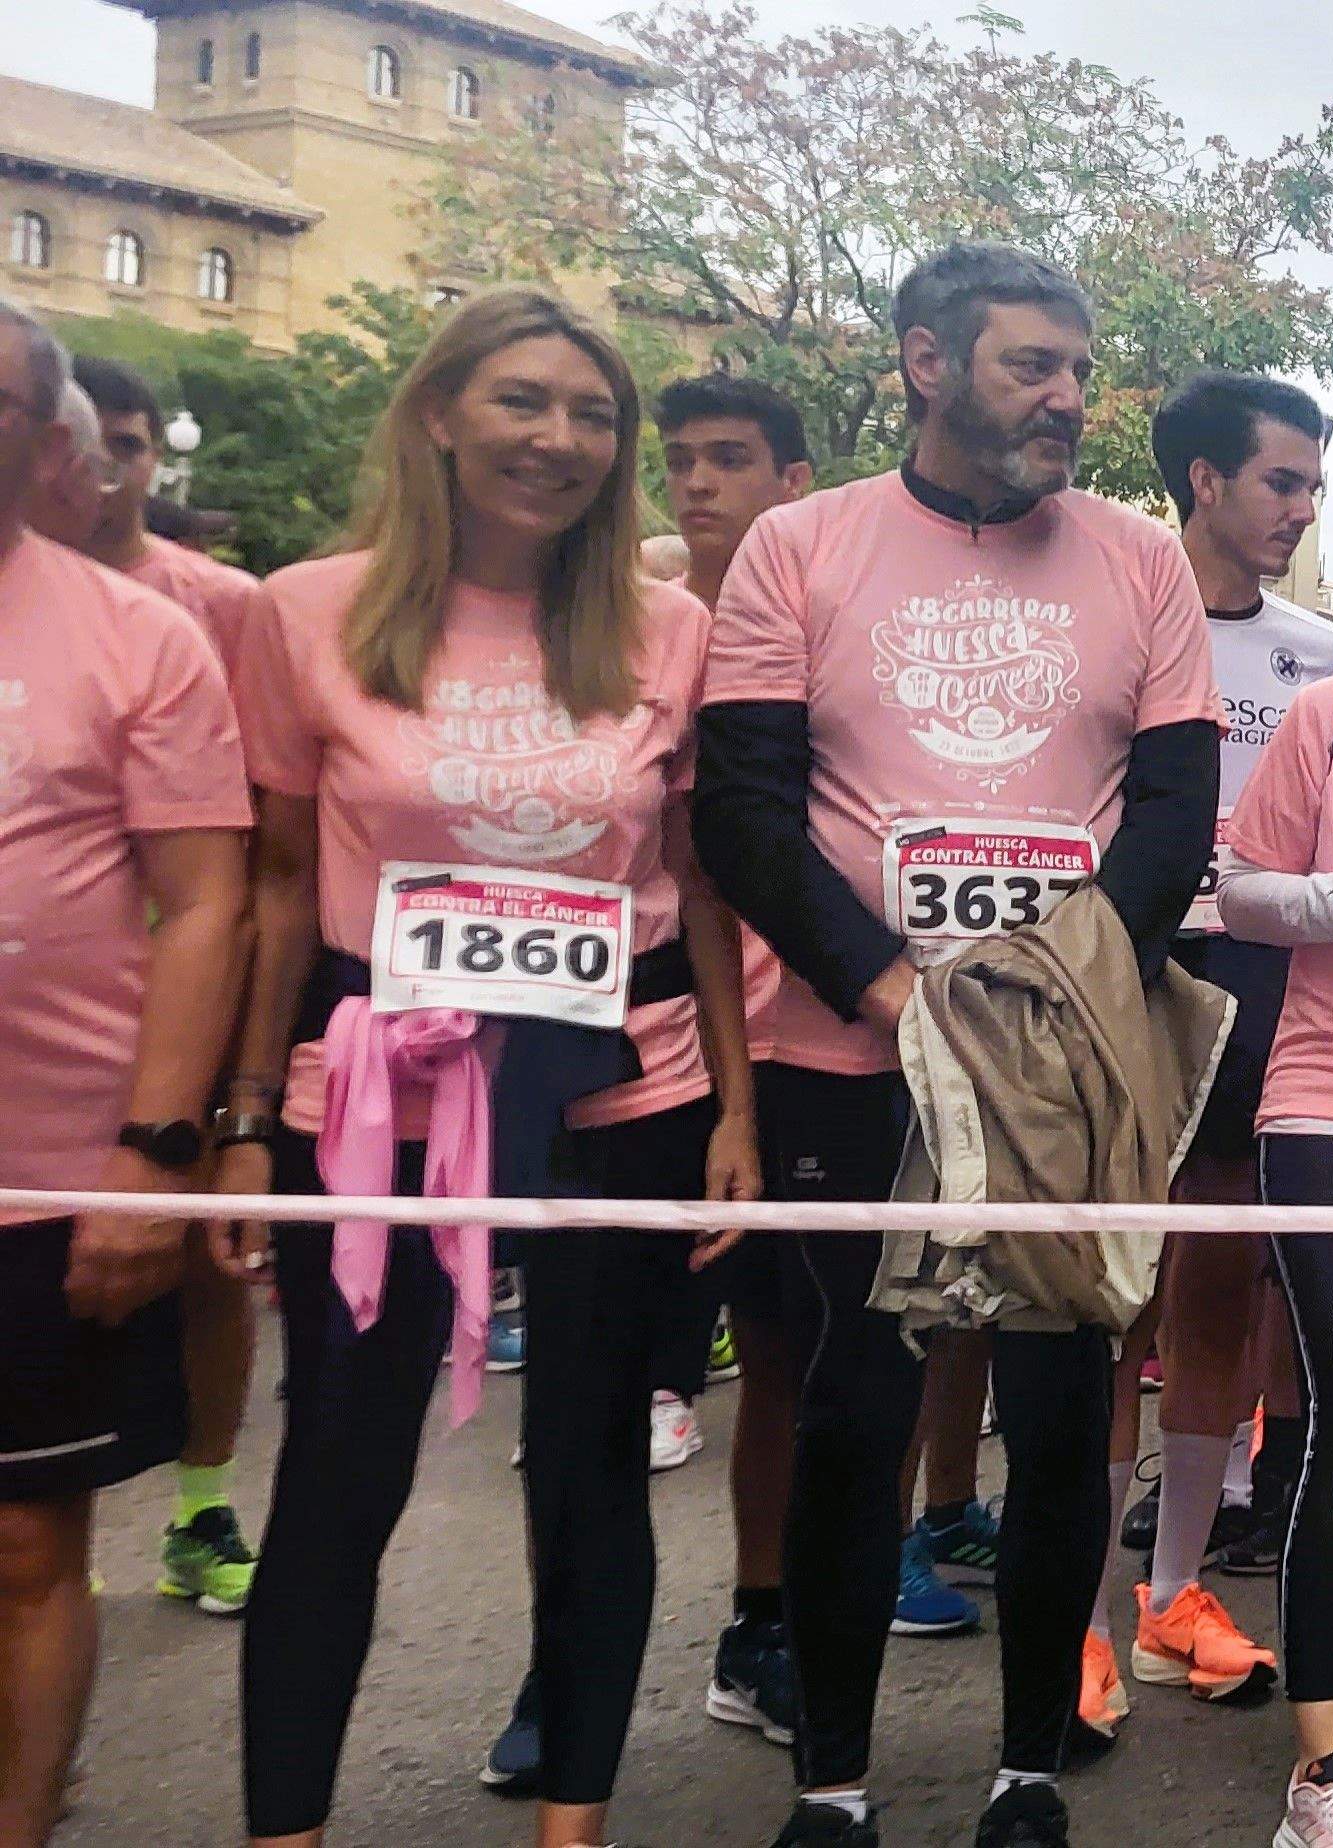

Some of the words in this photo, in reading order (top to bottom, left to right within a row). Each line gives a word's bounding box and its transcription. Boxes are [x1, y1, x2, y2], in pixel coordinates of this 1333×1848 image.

[974, 836, 1029, 850] HUESCA
[909, 847, 989, 867] CONTRA
[992, 852, 1014, 867] EL
[1017, 848, 1086, 870] CÁNCER
[483, 885, 543, 902] HUESCA
[408, 894, 497, 916] CONTRA
[502, 899, 527, 917] EL
[530, 900, 610, 928] CÁNCER
[407, 917, 610, 984] 1860
